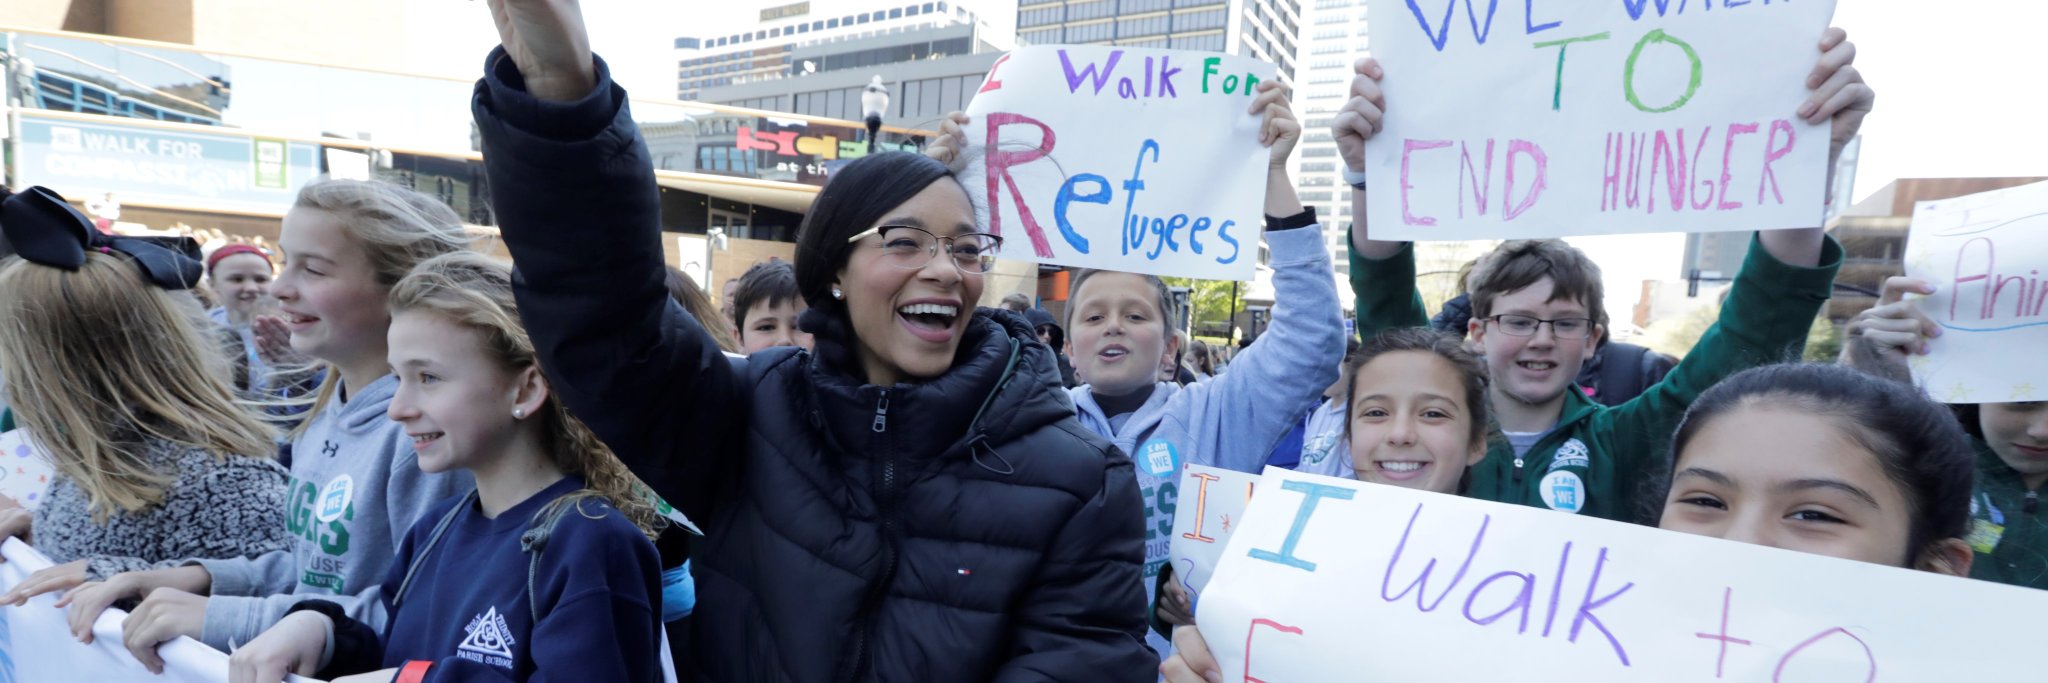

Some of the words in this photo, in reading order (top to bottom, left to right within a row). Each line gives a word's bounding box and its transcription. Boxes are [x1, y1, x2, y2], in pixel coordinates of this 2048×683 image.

[1057, 49, 1183, 100] Walk
[1201, 57, 1261, 96] For
[1532, 28, 1703, 113] TO
[83, 131, 152, 156] WALK
[158, 139, 204, 160] FOR
[776, 161, 799, 173] at
[806, 162, 829, 176] th
[985, 112, 1240, 265] Refugees
[1400, 138, 1548, 226] END
[1600, 119, 1797, 215] HUNGER
[1153, 455, 1170, 469] WE
[1183, 473, 1220, 543] I
[1556, 490, 1574, 505] WE
[1247, 479, 1357, 572] I
[1381, 502, 1635, 667] Walk
[464, 613, 481, 635] HOLY
[496, 613, 516, 646] TRINITY
[457, 649, 484, 663] PARISH
[485, 655, 513, 669] SCHOOL
